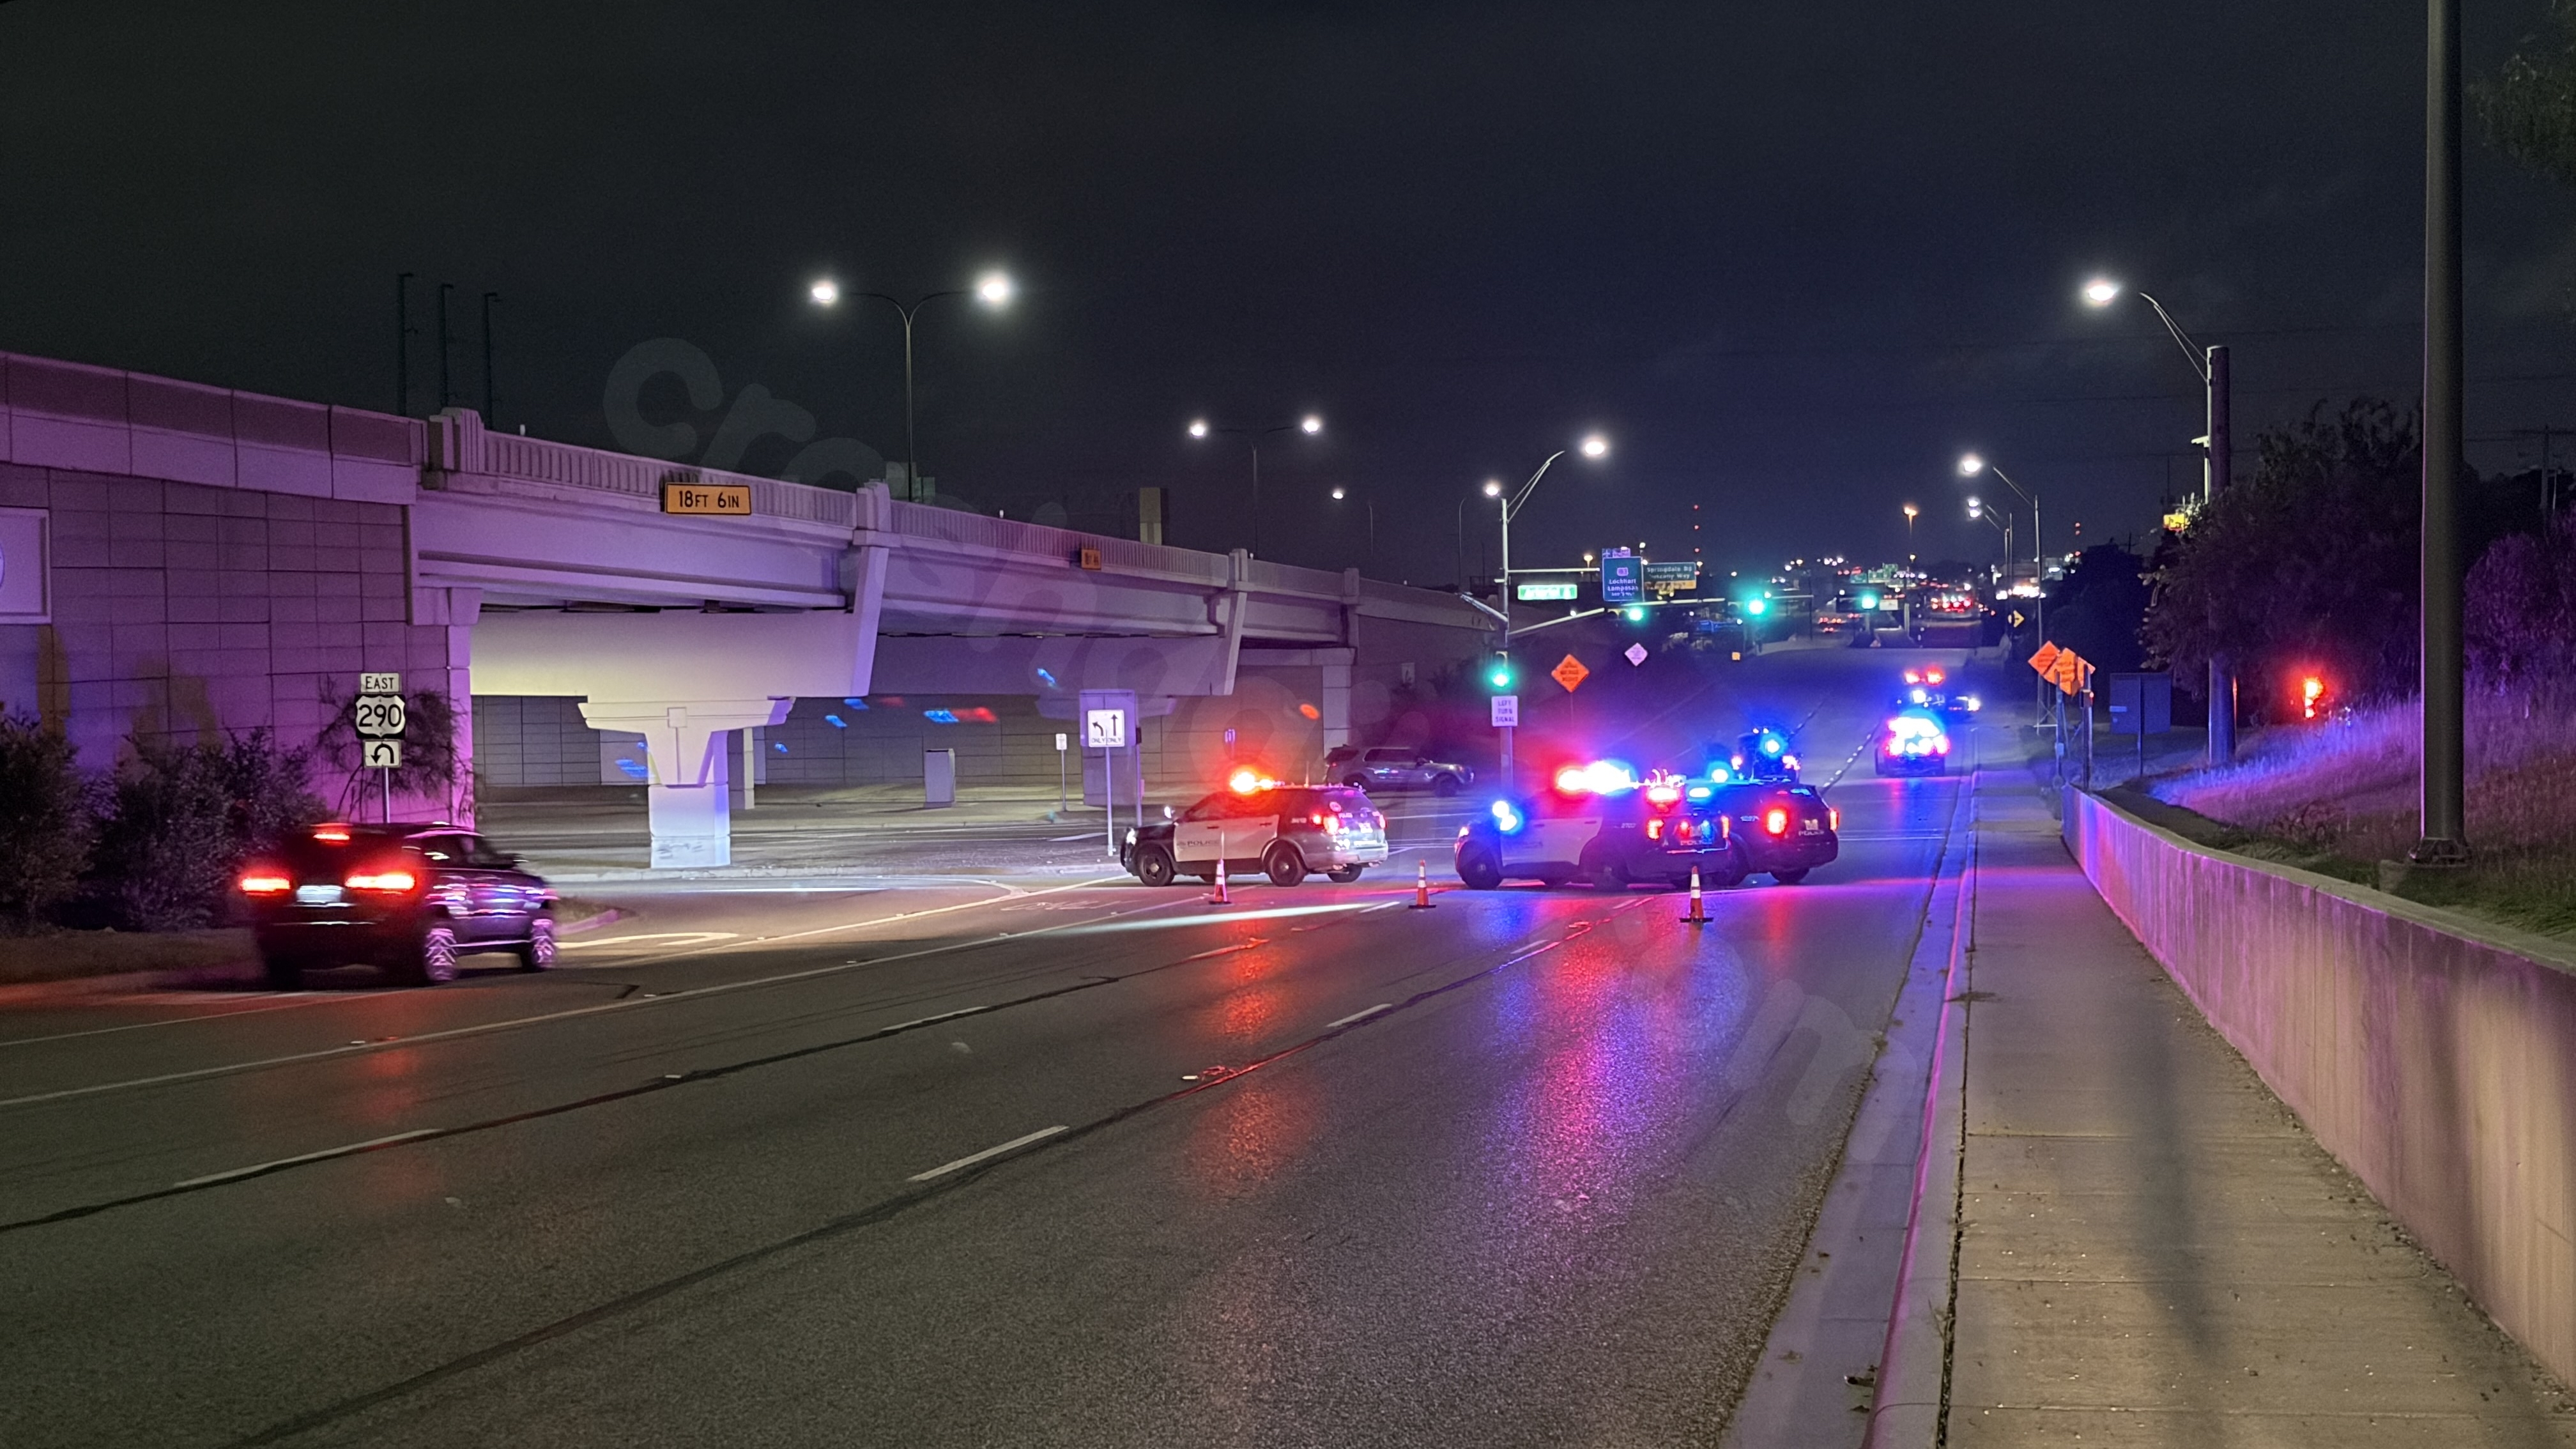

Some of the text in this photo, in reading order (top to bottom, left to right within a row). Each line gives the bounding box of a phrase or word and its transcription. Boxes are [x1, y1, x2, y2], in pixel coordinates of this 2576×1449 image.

[679, 490, 739, 508] 18FT 6IN
[365, 676, 394, 689] EAST
[358, 703, 402, 727] 290
